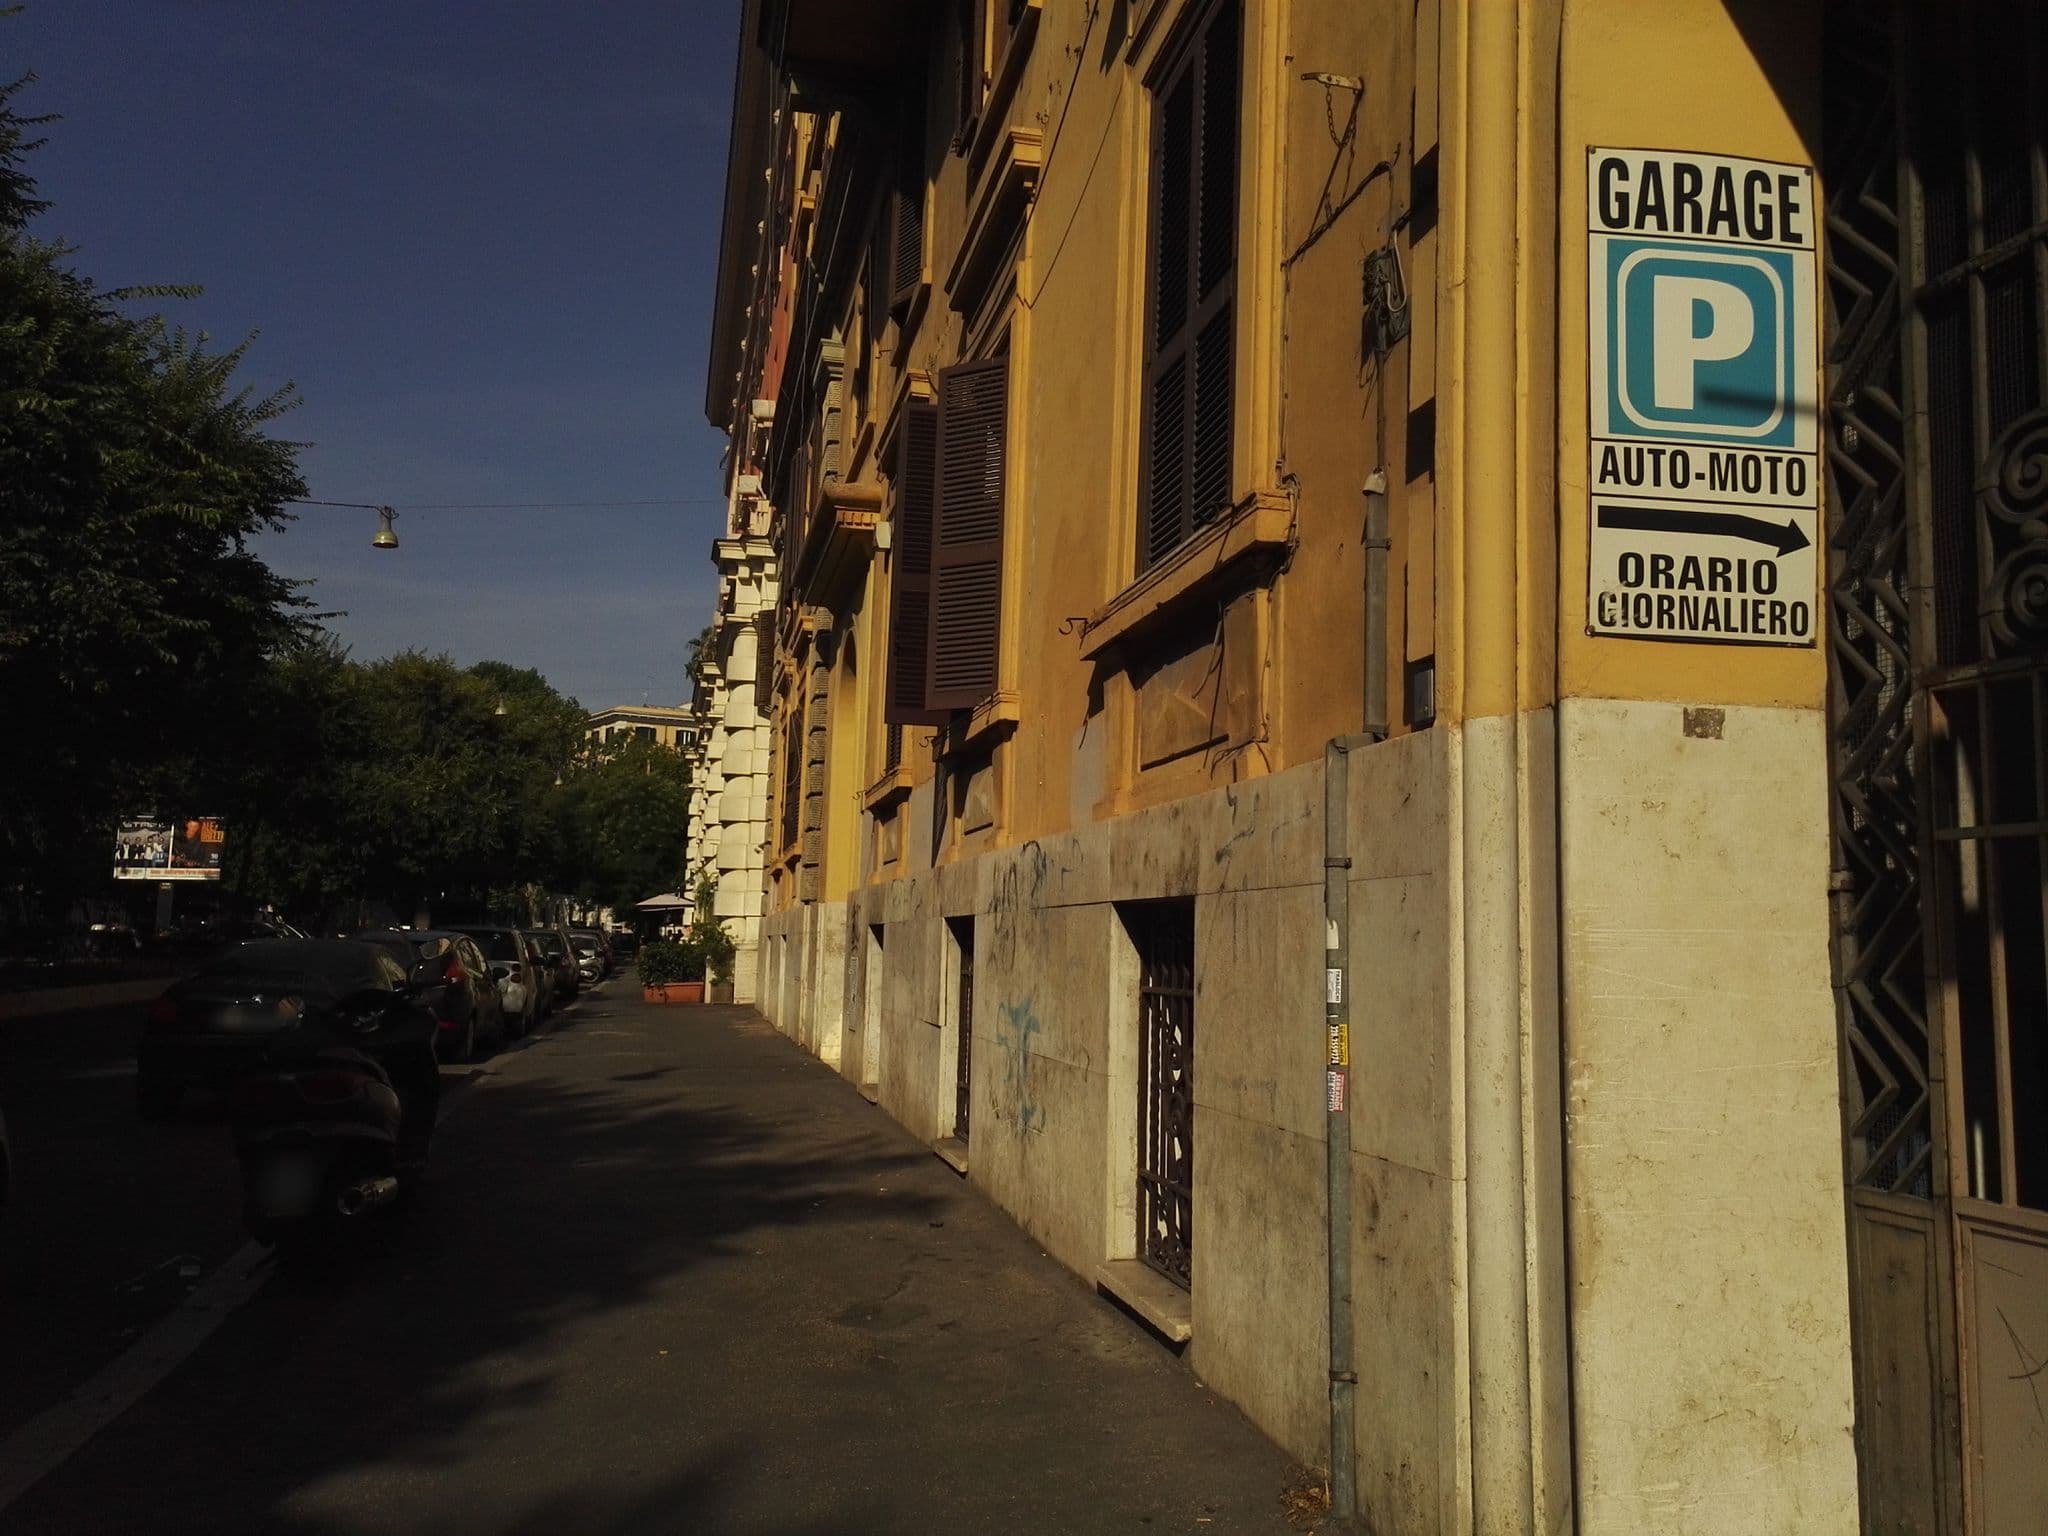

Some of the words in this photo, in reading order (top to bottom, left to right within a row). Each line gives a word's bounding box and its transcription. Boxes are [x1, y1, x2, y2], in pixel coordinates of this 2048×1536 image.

[1598, 157, 1803, 245] GARAGE
[1653, 274, 1755, 410] P
[1598, 445, 1806, 497] AUTO-MOTO
[1618, 551, 1778, 596] ORARIO
[1597, 591, 1809, 637] GIORNALIERO
